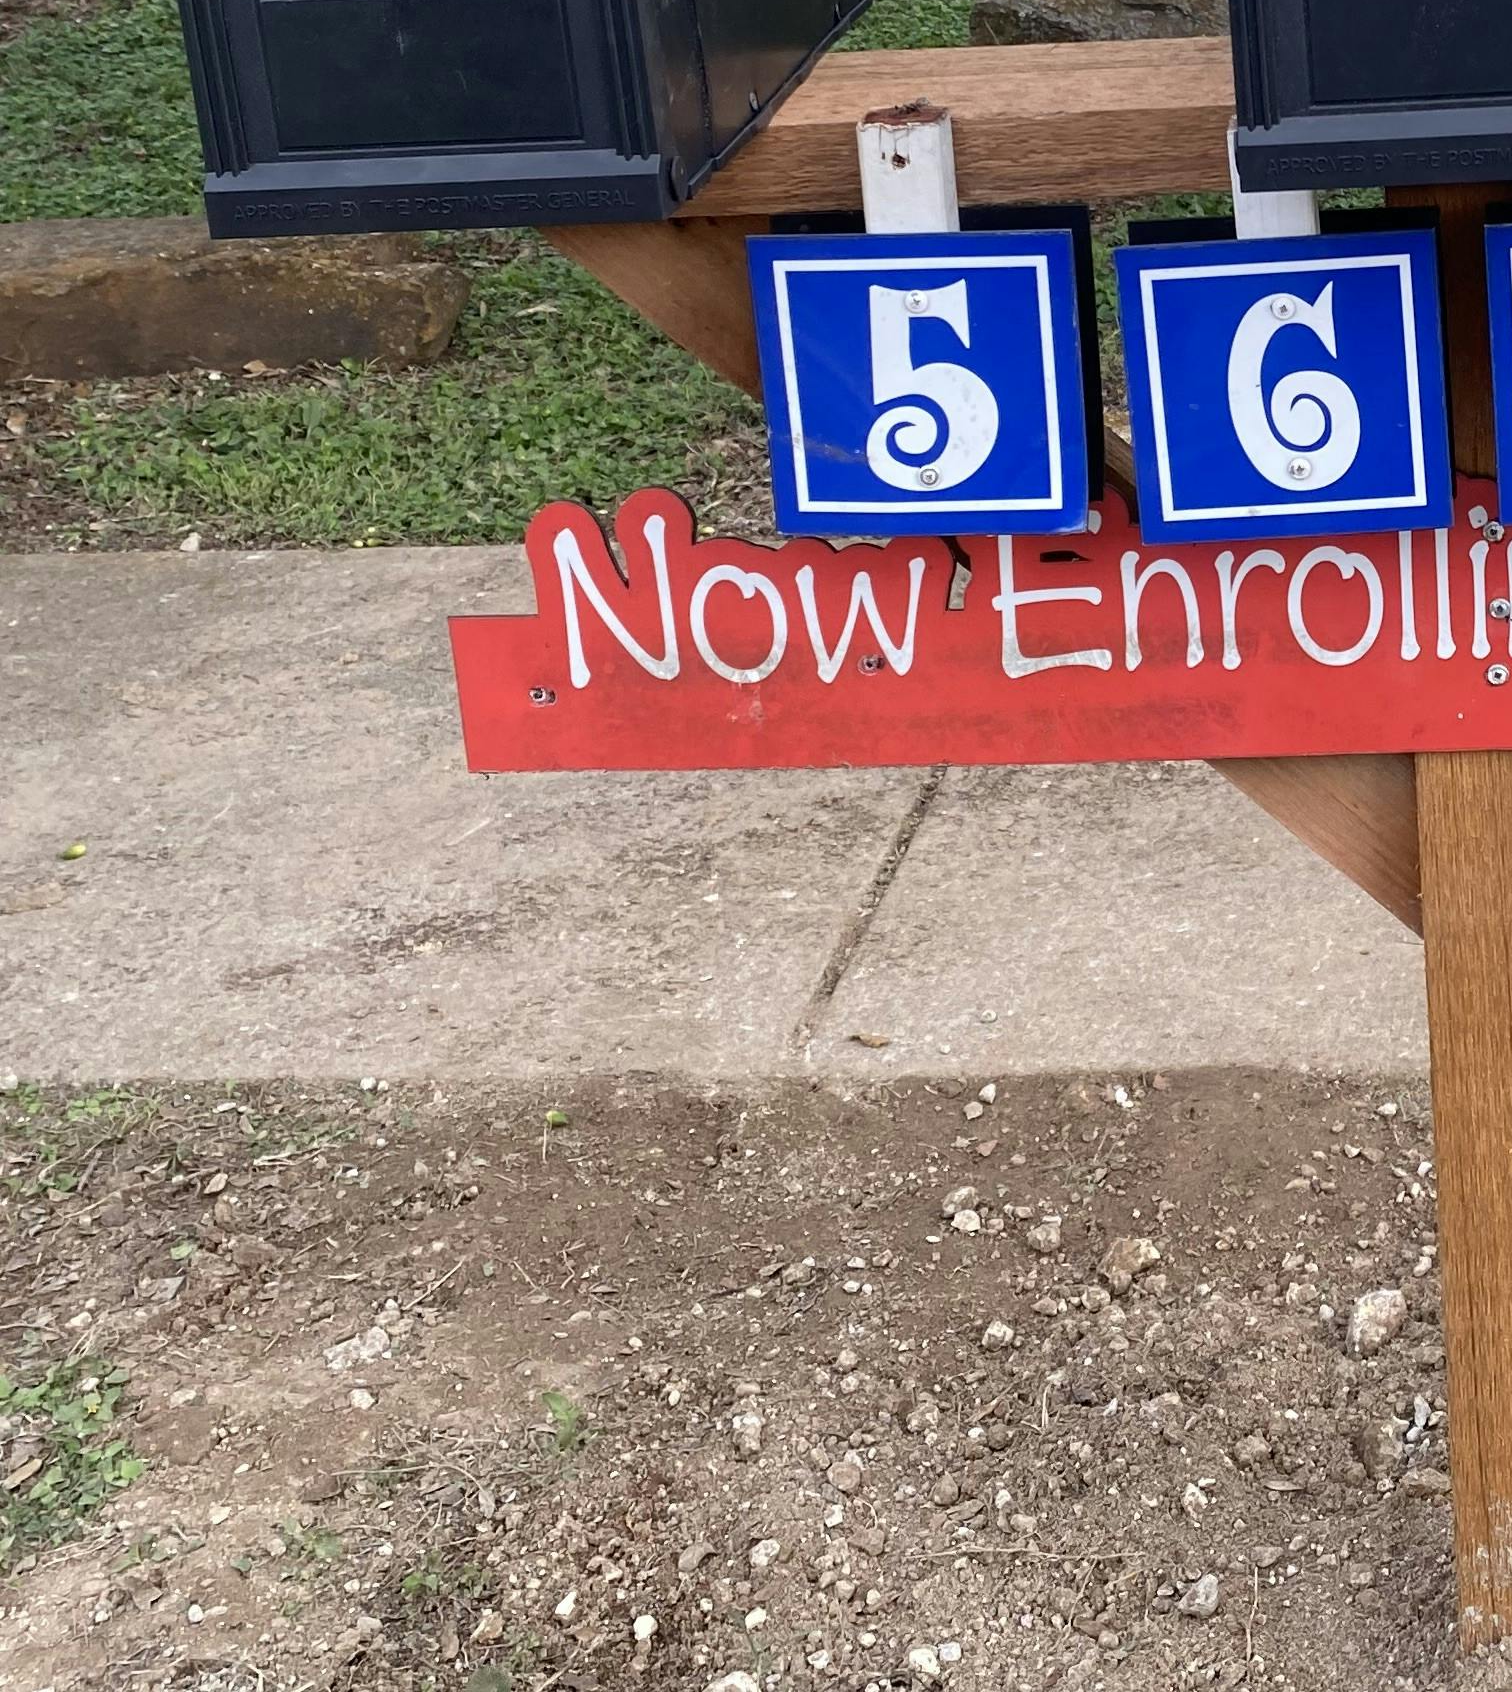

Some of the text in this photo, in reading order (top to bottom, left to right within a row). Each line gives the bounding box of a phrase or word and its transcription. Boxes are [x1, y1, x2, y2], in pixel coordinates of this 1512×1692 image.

[232, 188, 635, 221] APPROVED BY THE POSTMASTER GENERAL
[1266, 155, 1364, 176] APPROVED
[1372, 153, 1394, 172] BY
[1400, 150, 1441, 169] THE
[866, 279, 999, 492] 5
[1227, 281, 1361, 492] 6
[552, 514, 925, 689] Now
